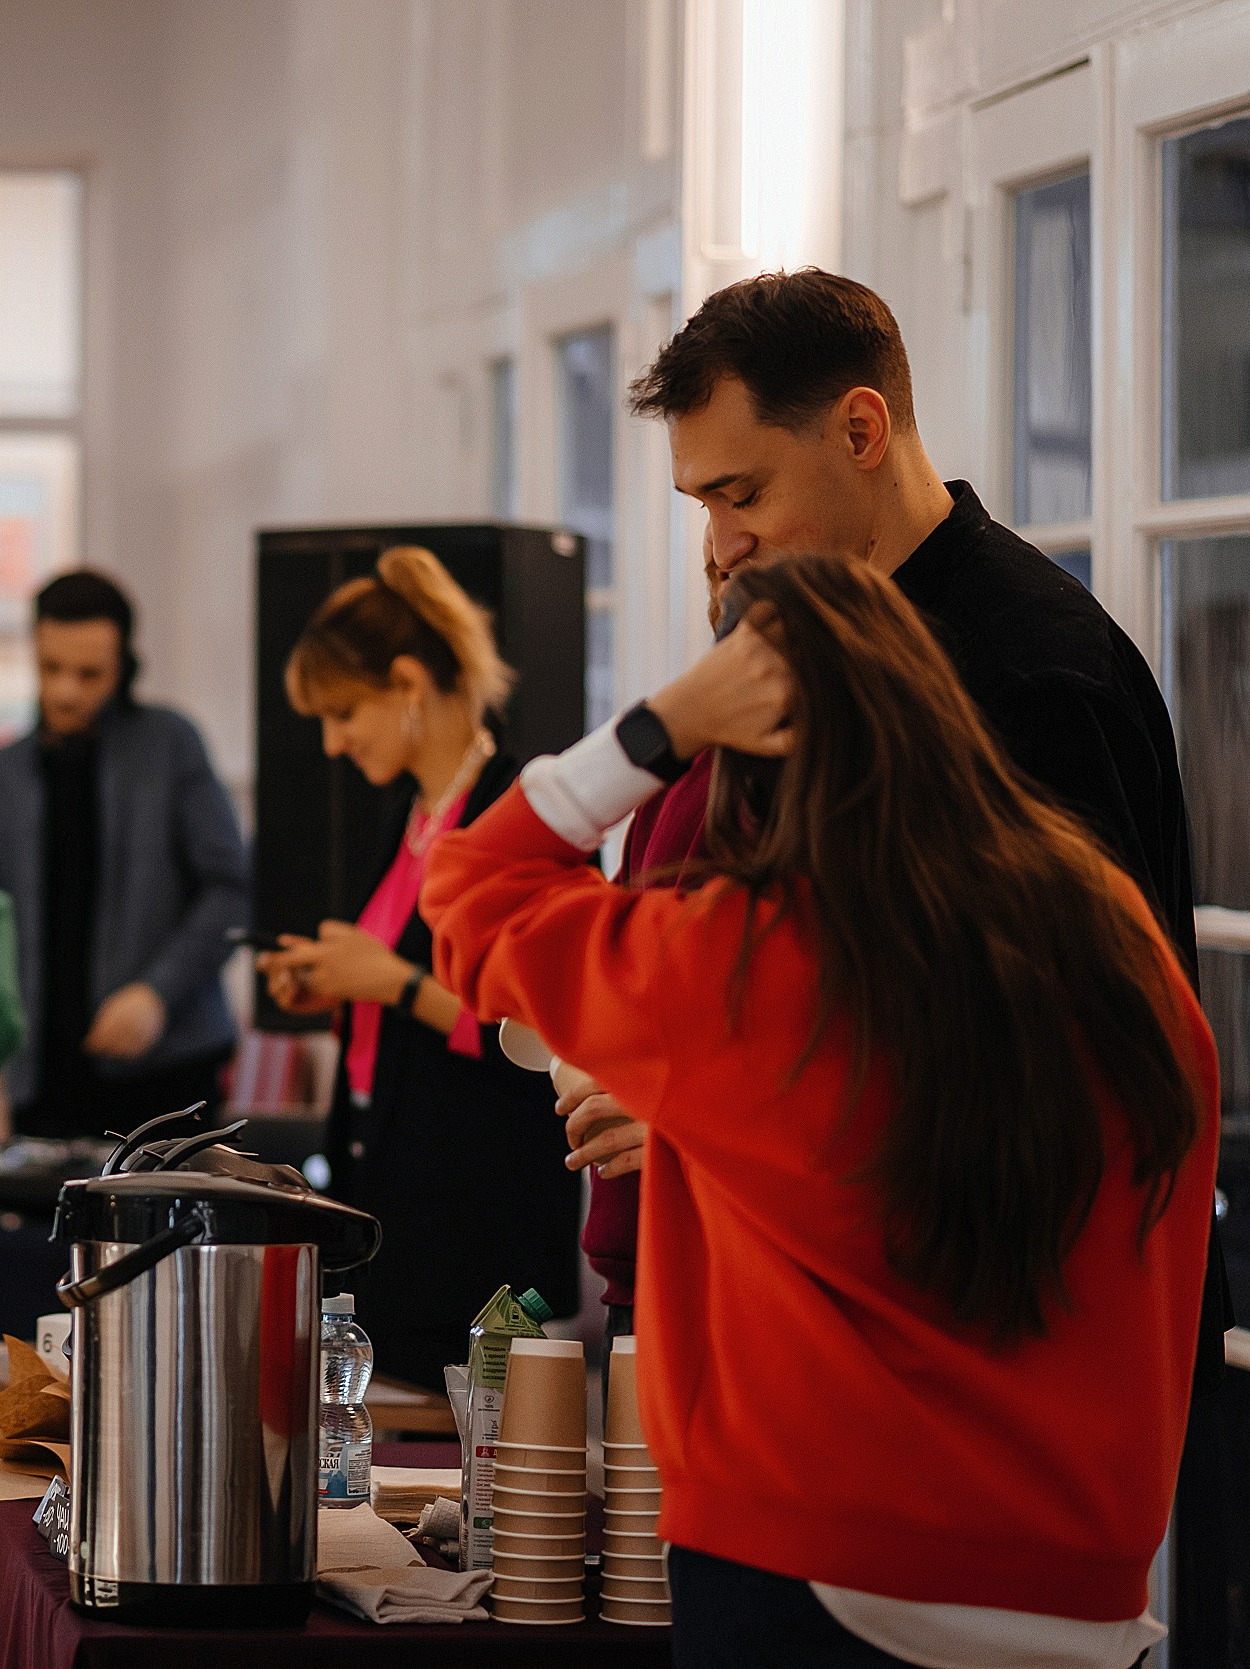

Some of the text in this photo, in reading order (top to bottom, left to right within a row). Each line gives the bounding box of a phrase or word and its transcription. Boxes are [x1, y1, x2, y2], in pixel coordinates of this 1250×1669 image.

[43, 1333, 52, 1353] 6
[319, 1458, 340, 1469] СКАЯ
[56, 1502, 70, 1531] ЧАЙ
